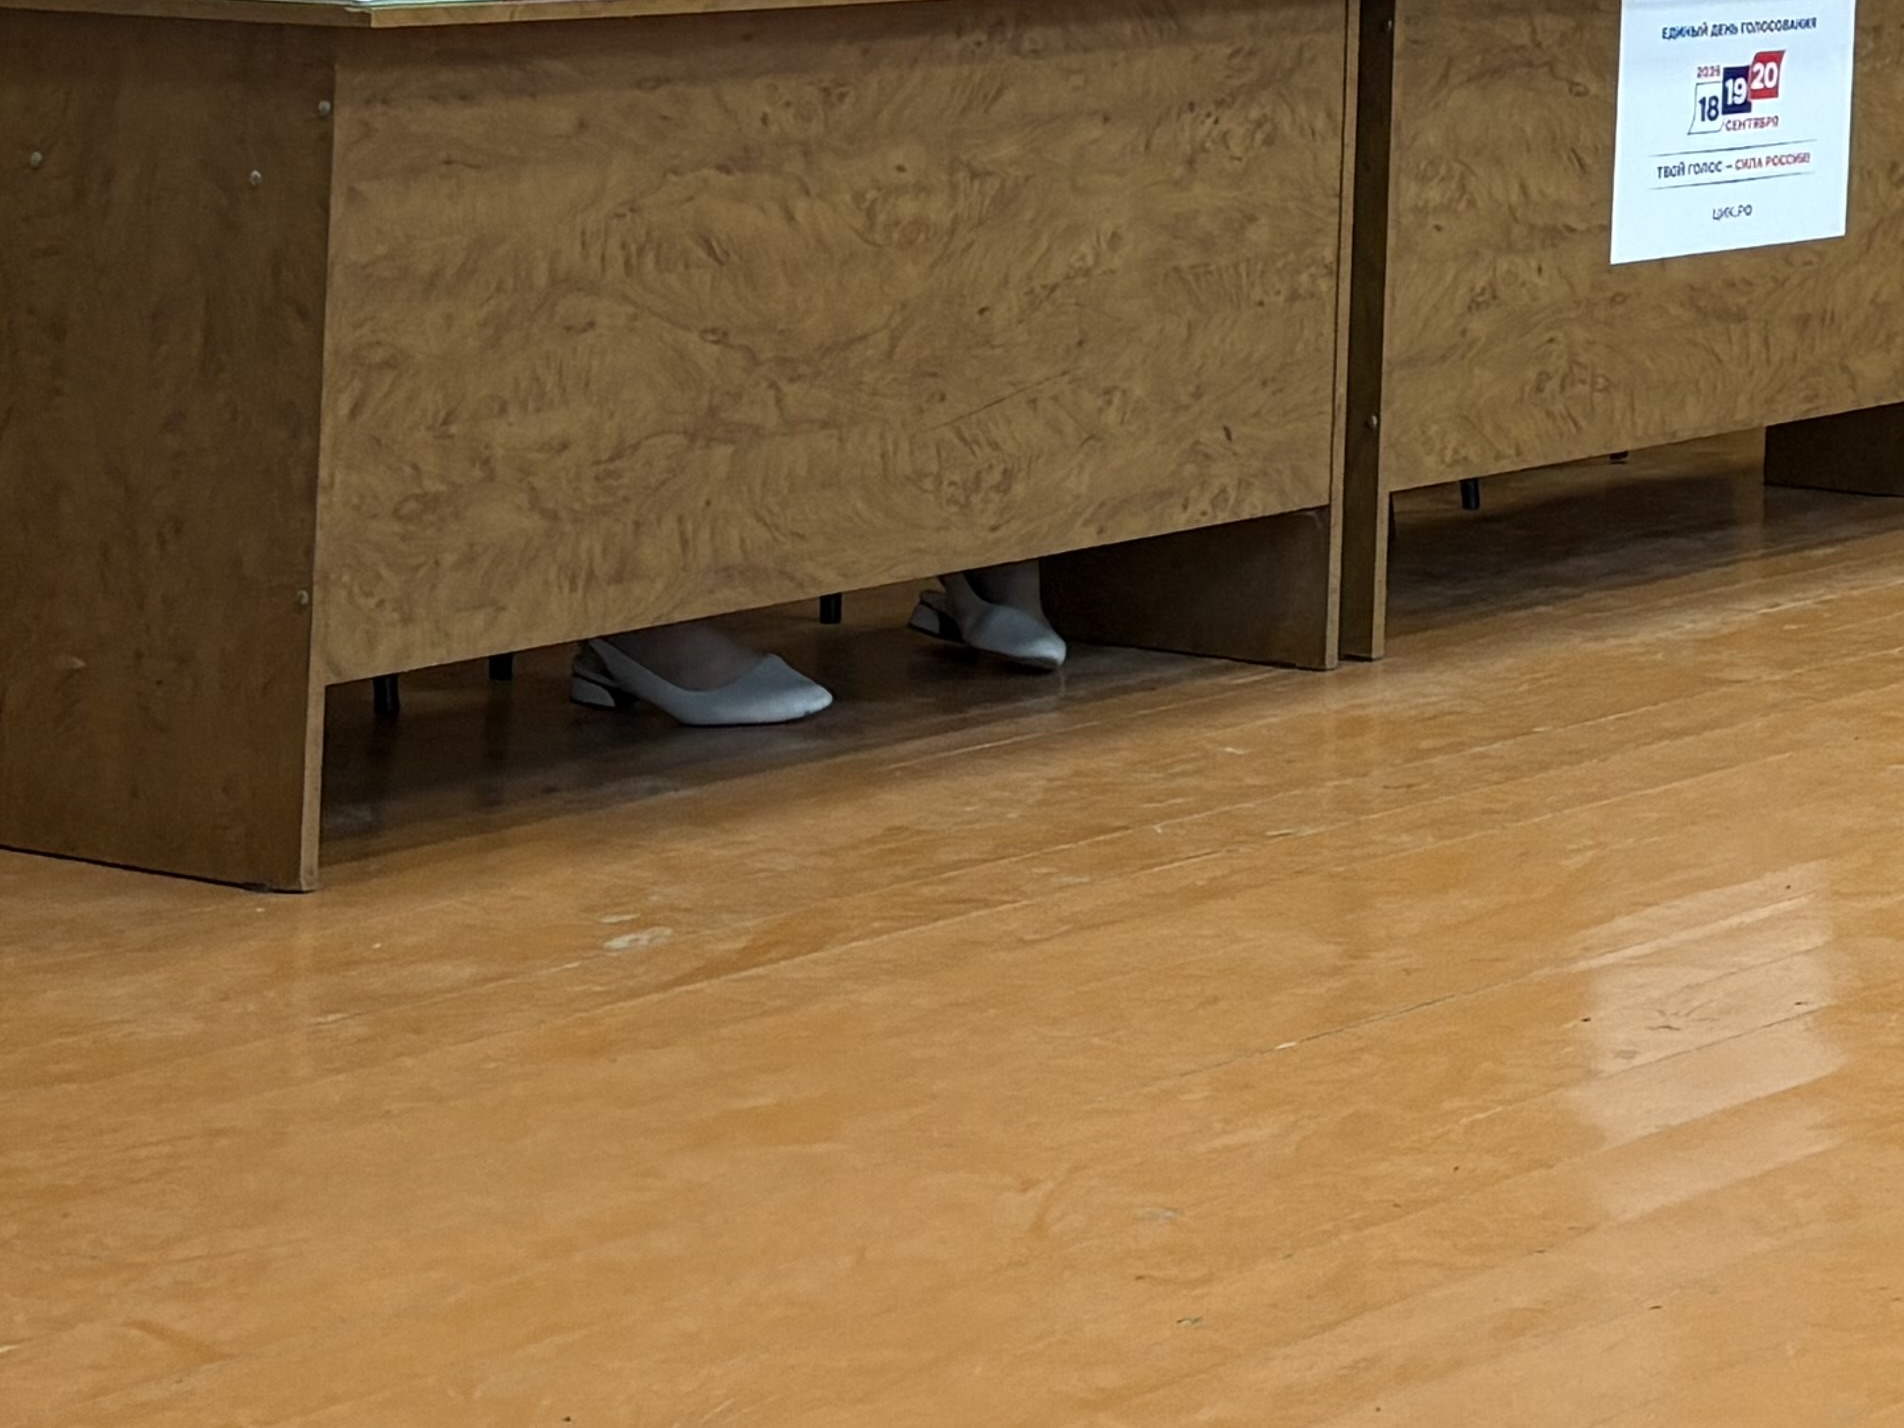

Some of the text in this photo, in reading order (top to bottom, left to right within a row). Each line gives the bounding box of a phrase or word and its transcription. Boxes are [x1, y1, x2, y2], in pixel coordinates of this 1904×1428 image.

[1661, 16, 1817, 40] ЕДИНЫЙ ДЕНЬ ГОЛОСОВАНИЯ
[1750, 61, 1778, 91] 20
[1725, 77, 1748, 106] 19
[1698, 95, 1720, 122] 18
[1725, 114, 1780, 132] СЕНТЯБРЯ
[1657, 161, 1686, 180] ТВОЙ
[1688, 159, 1723, 176] ГОЛОС
[1734, 156, 1763, 172] СИЛА
